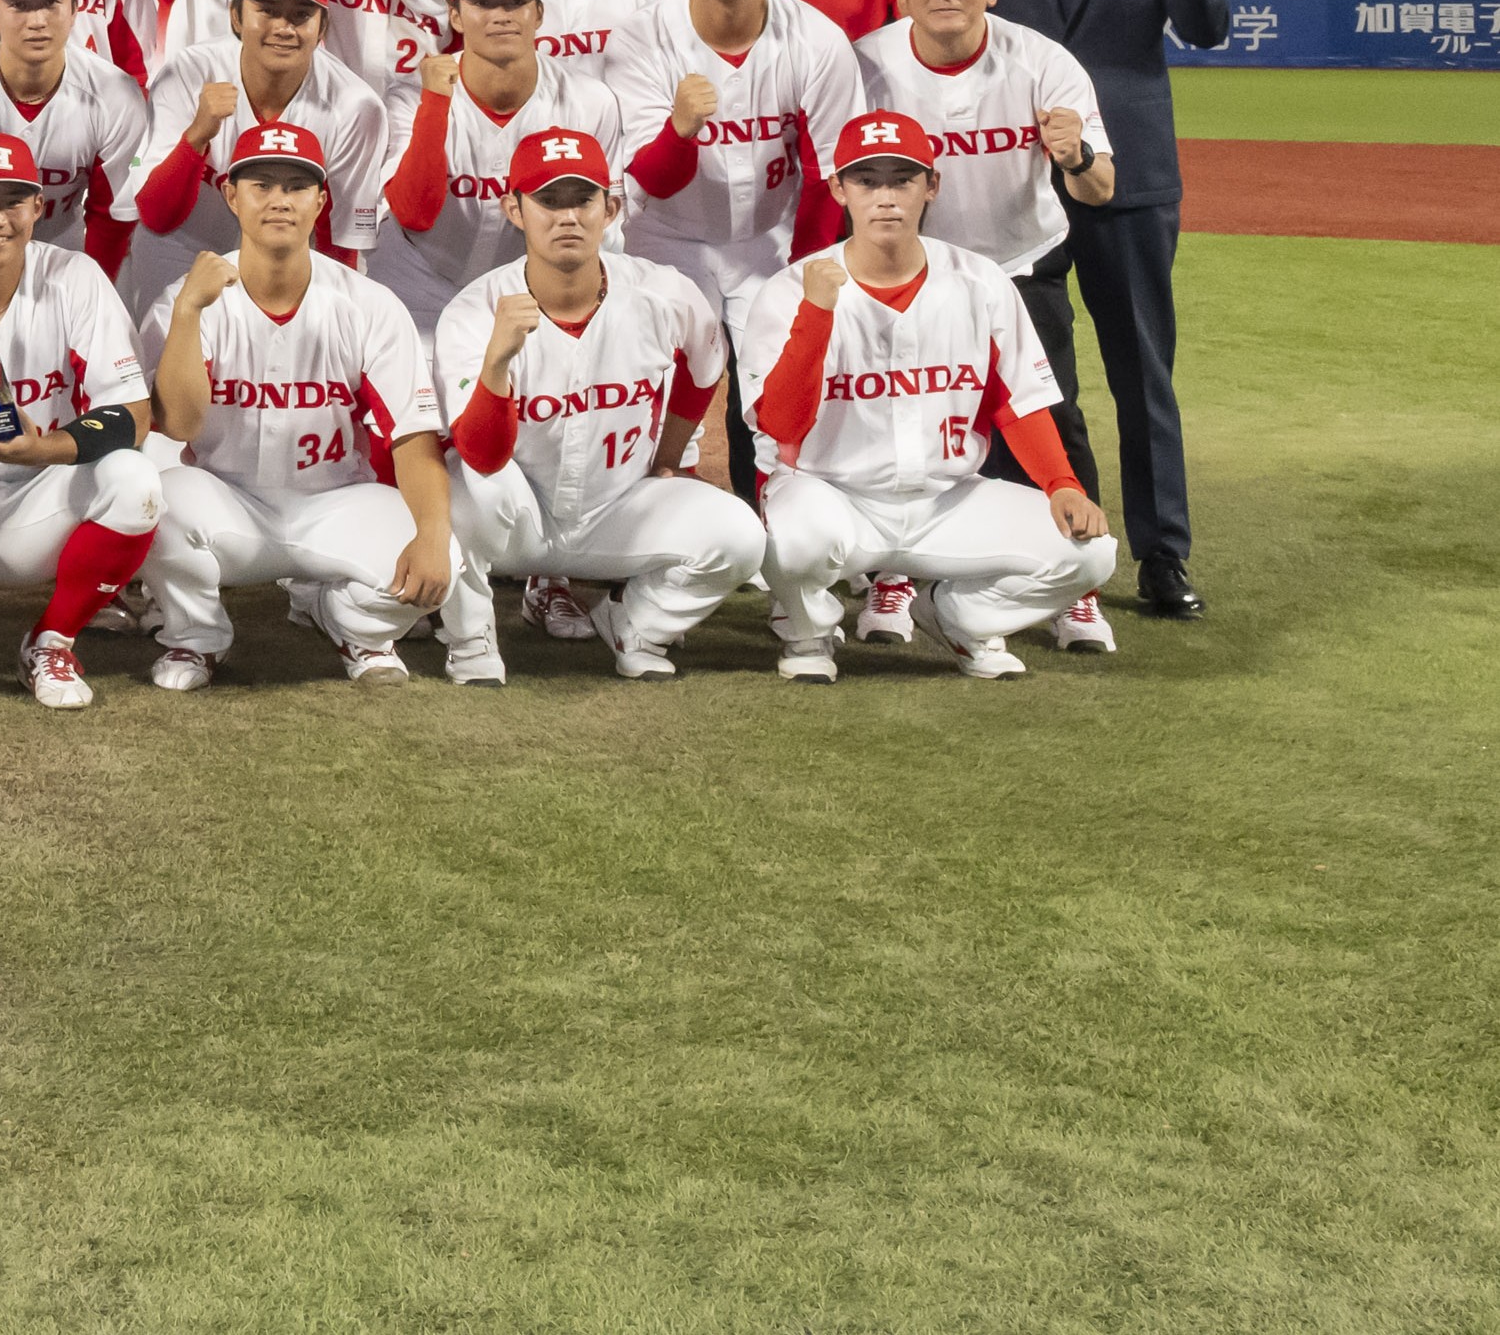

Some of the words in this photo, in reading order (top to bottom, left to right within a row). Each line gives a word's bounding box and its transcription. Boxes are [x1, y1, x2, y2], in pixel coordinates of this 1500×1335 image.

[1430, 34, 1500, 55] グルー
[259, 128, 299, 153] H
[697, 112, 799, 147] ONDA
[860, 122, 901, 146] H
[925, 126, 1041, 160] ONDA
[541, 137, 583, 162] H
[209, 378, 357, 409] HONDA
[516, 378, 658, 423] HONDA
[824, 365, 986, 402] HONDA
[297, 428, 347, 470] 34
[602, 426, 642, 469] 12
[939, 415, 970, 461] 15
